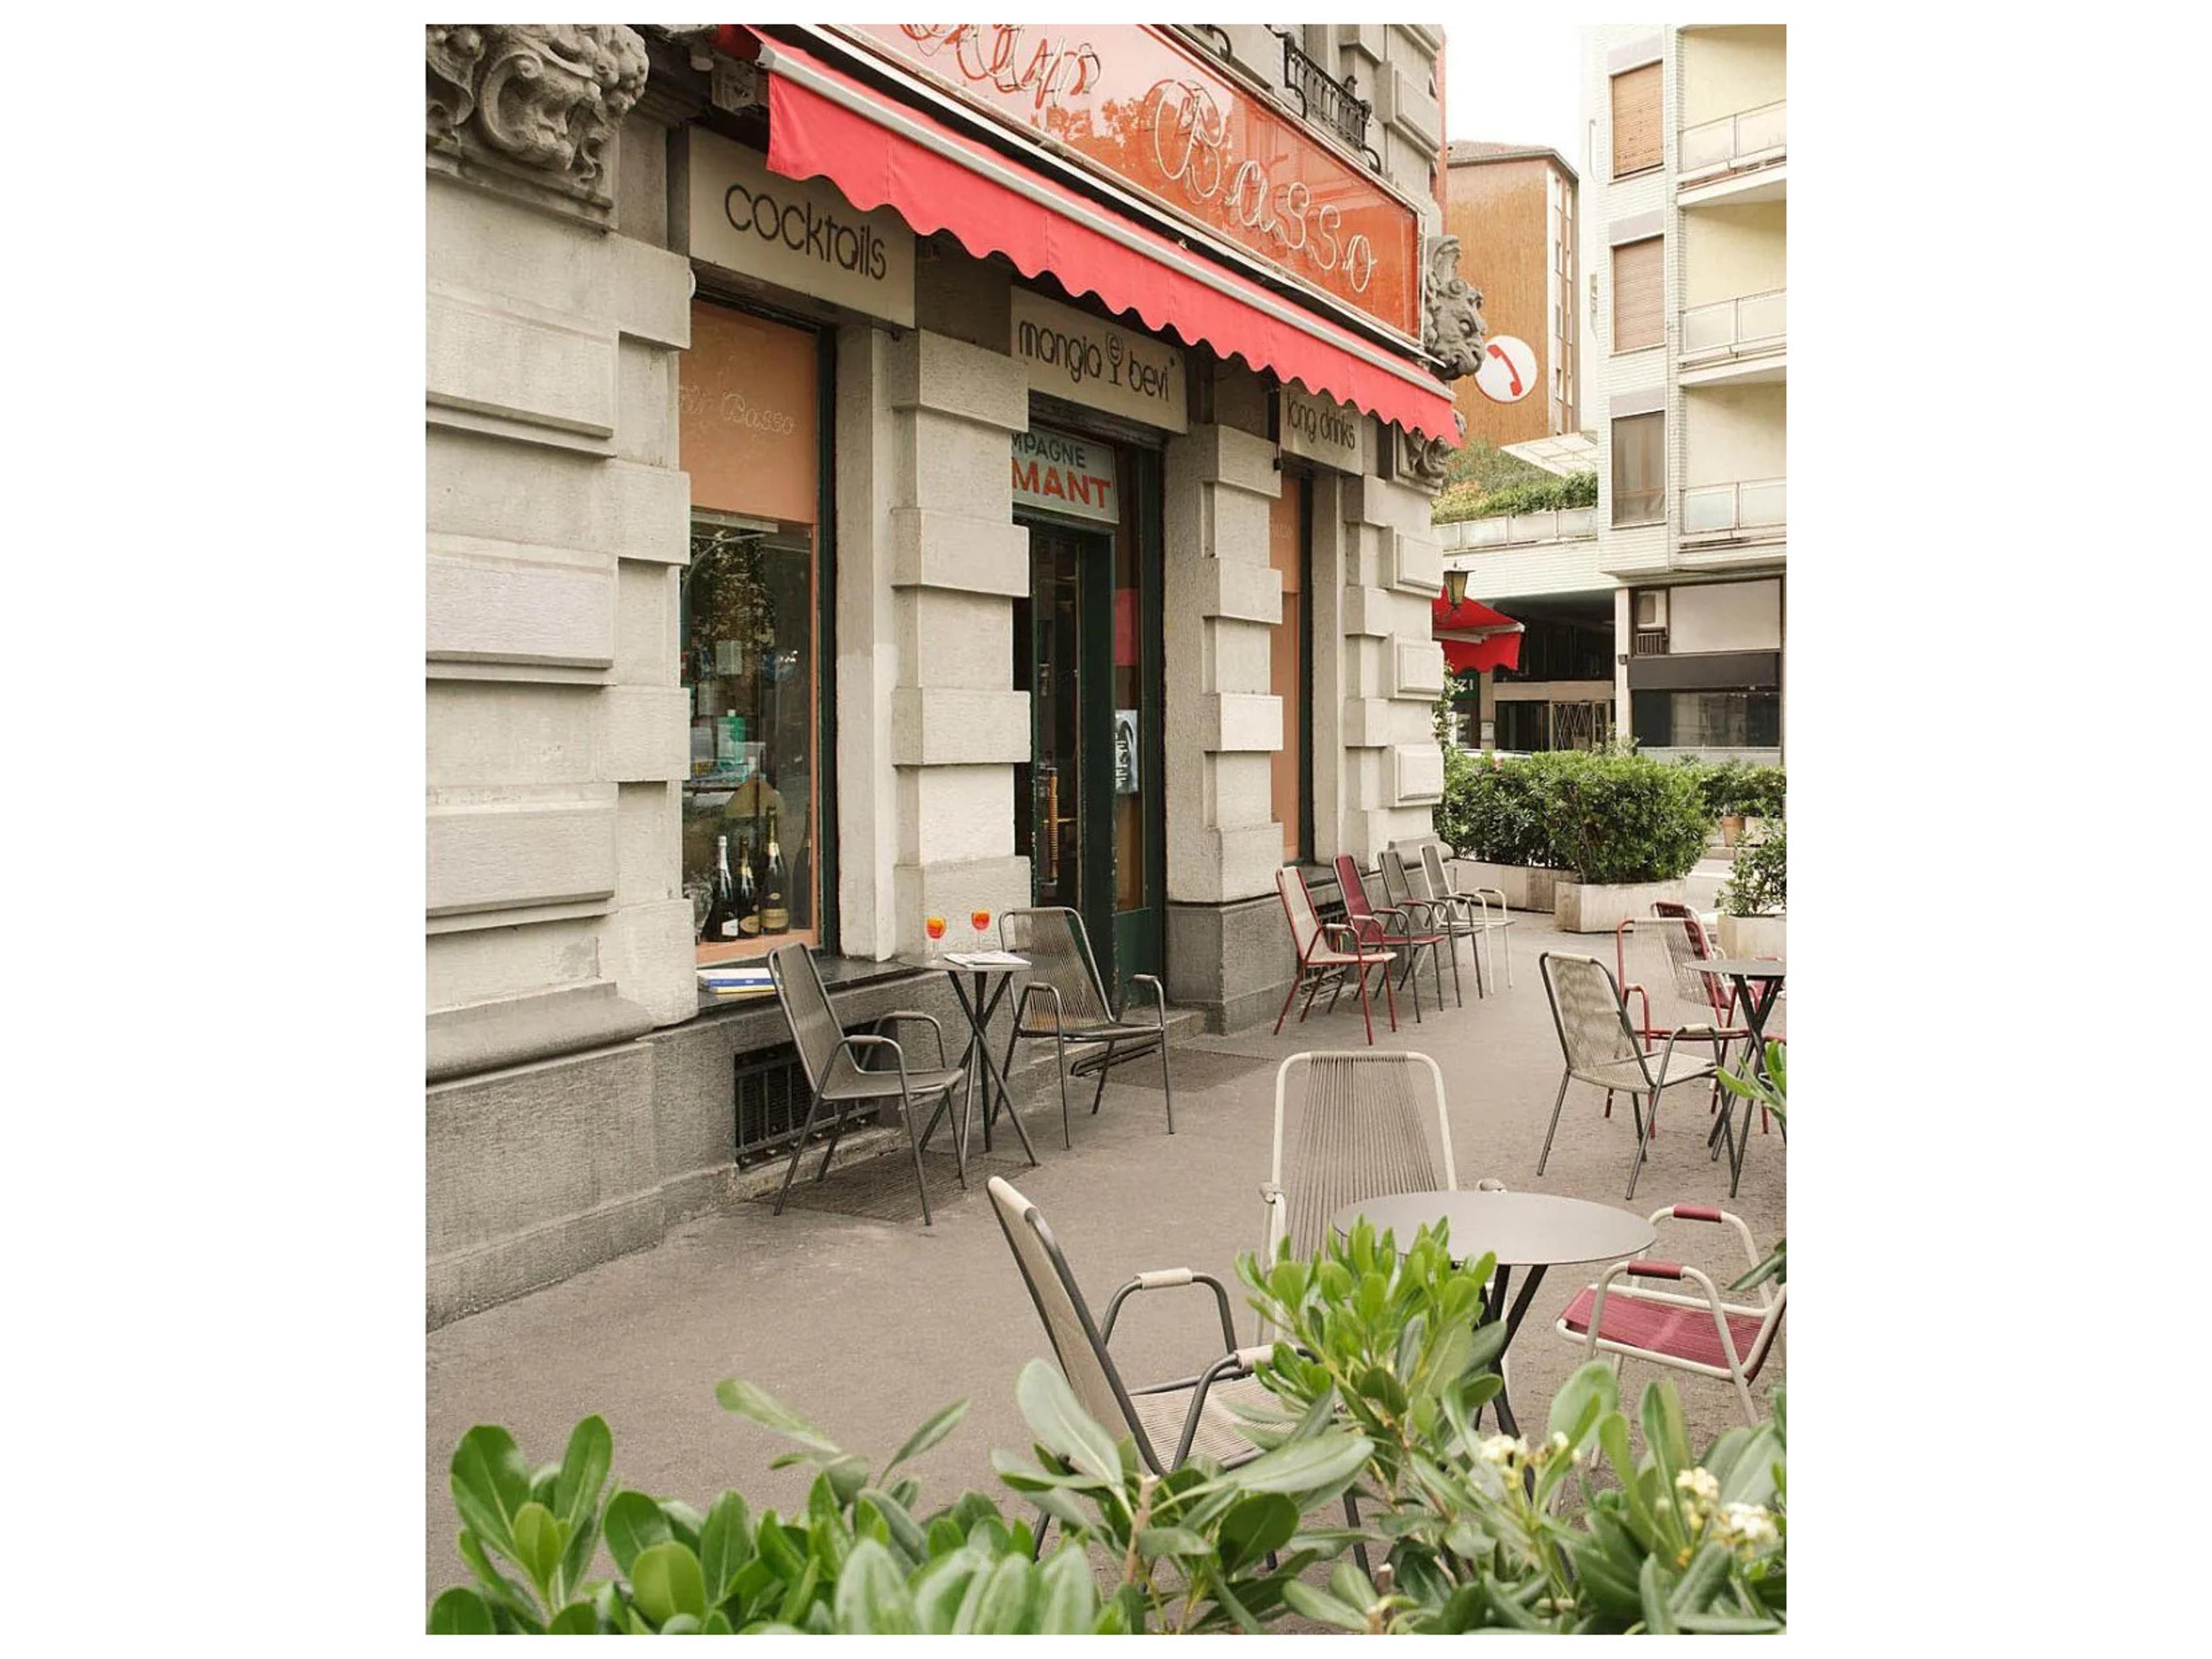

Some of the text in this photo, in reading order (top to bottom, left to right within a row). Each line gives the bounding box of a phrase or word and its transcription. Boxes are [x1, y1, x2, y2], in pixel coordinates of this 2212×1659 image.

[1153, 79, 1378, 293] Basso
[725, 184, 887, 281] cocktails
[1128, 350, 1169, 402] bevi
[721, 393, 796, 434] Basso
[1286, 392, 1355, 450] long drinks
[1011, 456, 1112, 508] MANT
